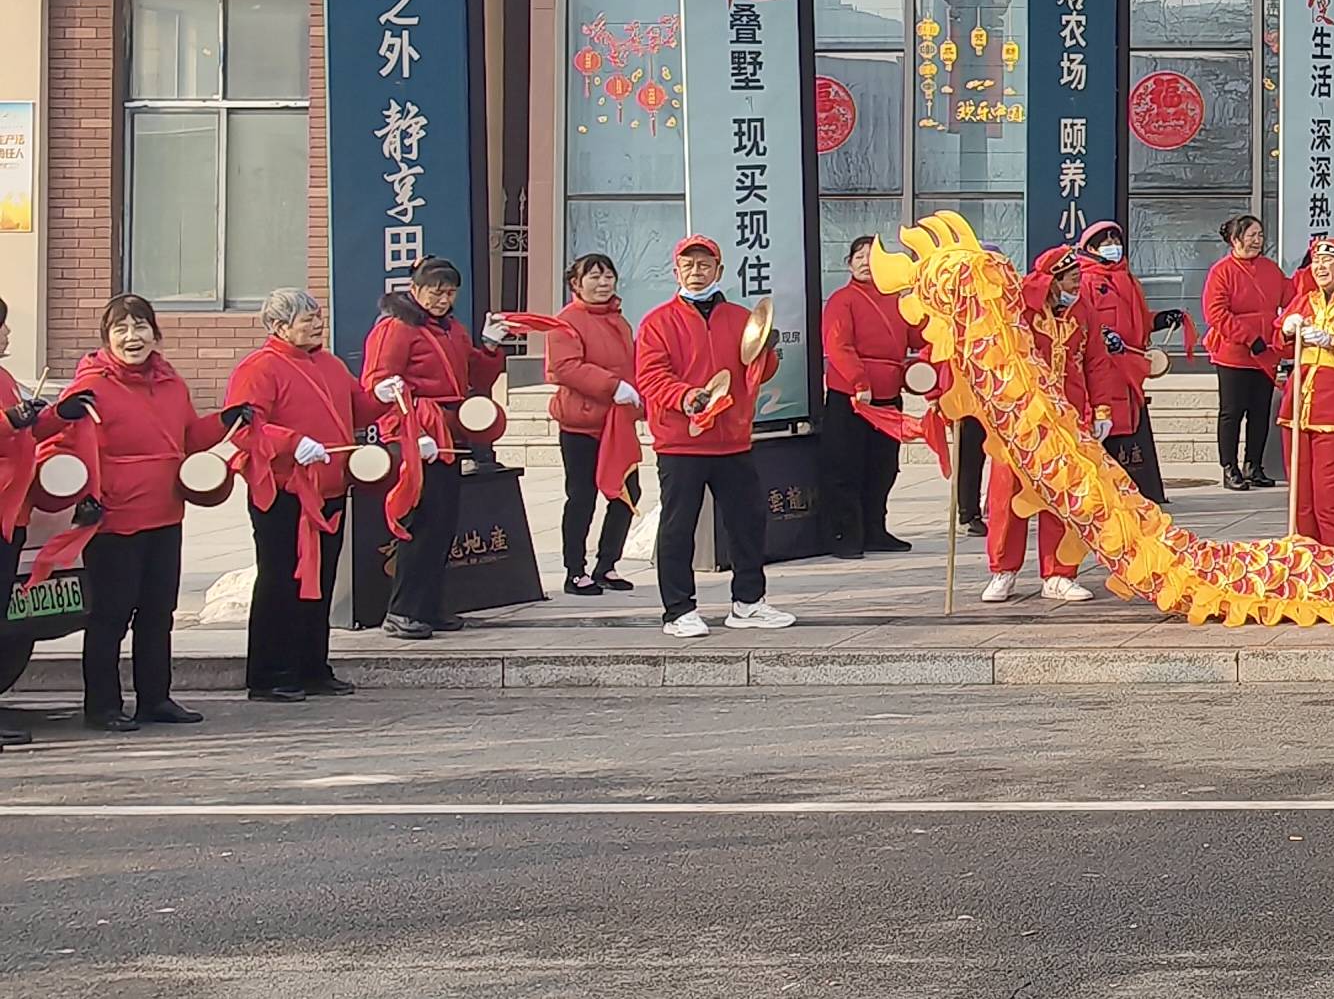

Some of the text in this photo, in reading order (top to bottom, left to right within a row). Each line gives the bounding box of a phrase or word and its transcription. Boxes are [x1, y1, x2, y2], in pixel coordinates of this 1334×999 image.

[373, 98, 428, 294] 静享田
[955, 99, 1025, 123] 欢乐中国
[732, 117, 772, 298] 现买现住
